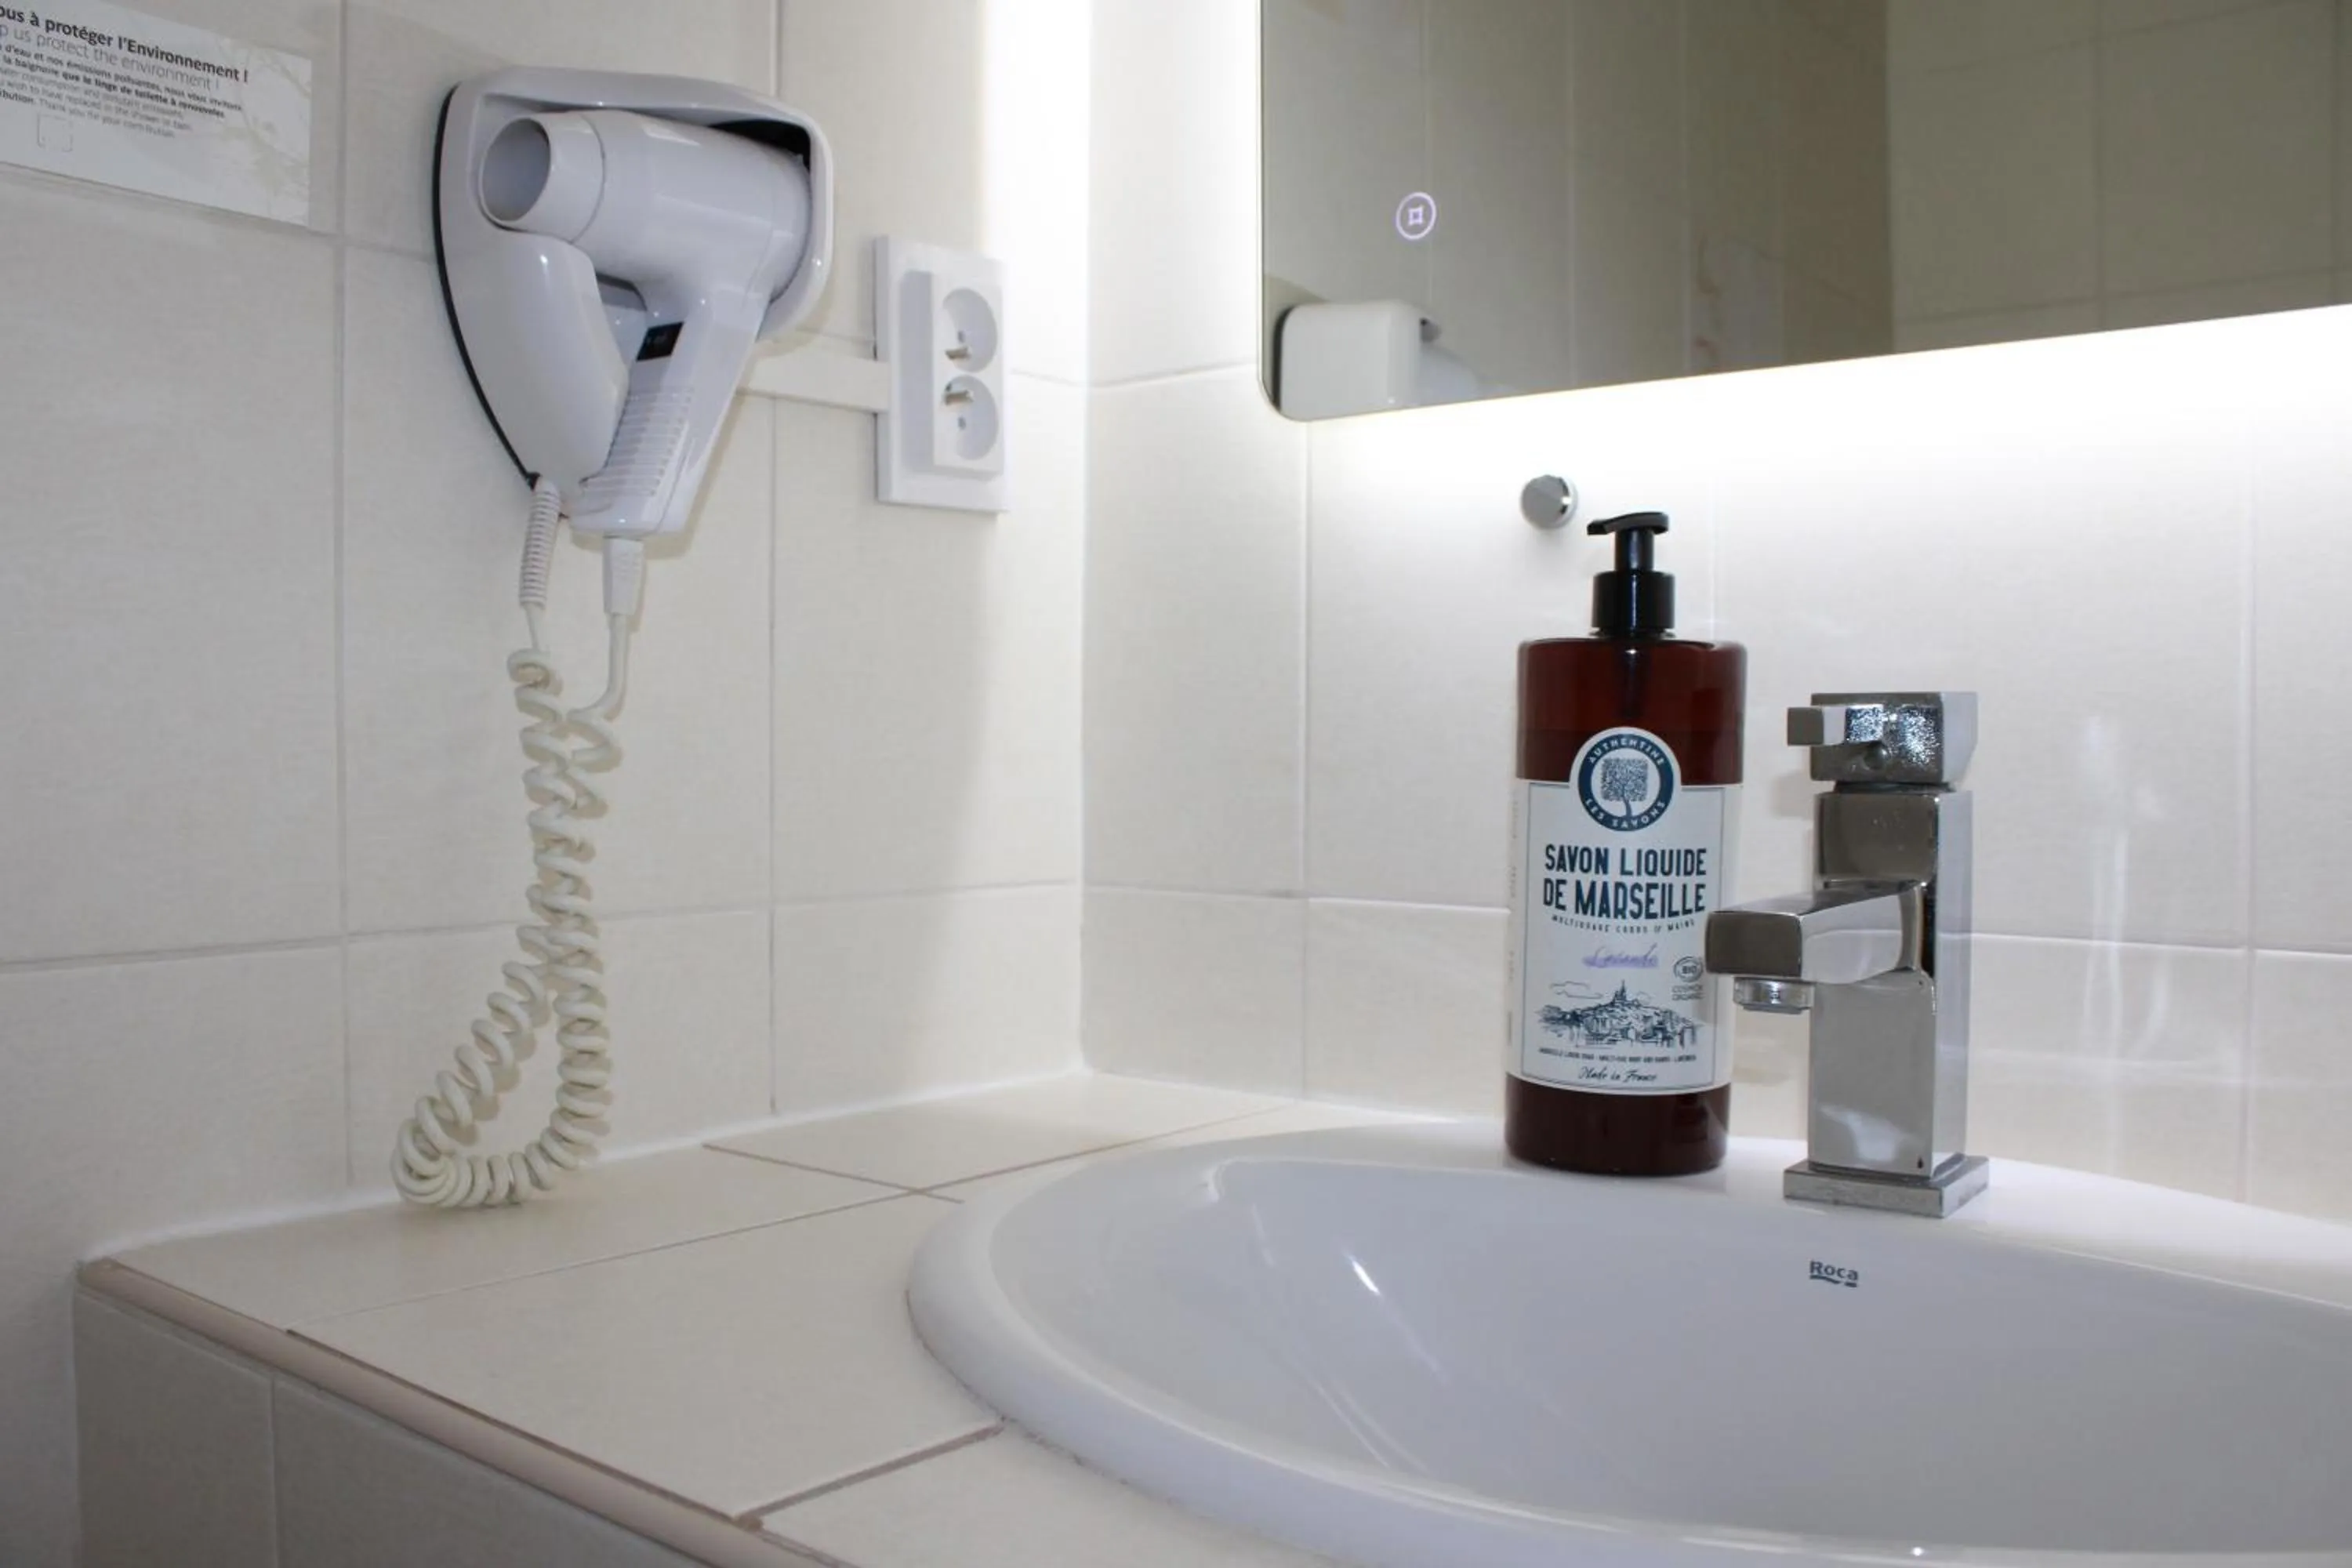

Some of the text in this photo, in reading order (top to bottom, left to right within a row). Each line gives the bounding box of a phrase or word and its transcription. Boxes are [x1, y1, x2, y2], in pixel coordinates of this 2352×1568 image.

[14, 29, 31, 42] us
[37, 34, 89, 60] protect
[94, 48, 118, 65] the
[122, 56, 211, 91] environment
[30, 12, 39, 26] à
[45, 18, 114, 46] protéger
[118, 36, 240, 82] l'Environnement
[1589, 738, 1664, 766] AUTHENTINE
[1612, 800, 1666, 829] SAVONS
[1544, 843, 1707, 877] SAVON LIQUIDE
[1543, 877, 1706, 920] DE MARSEILLE
[1809, 1259, 1859, 1282] Roca
